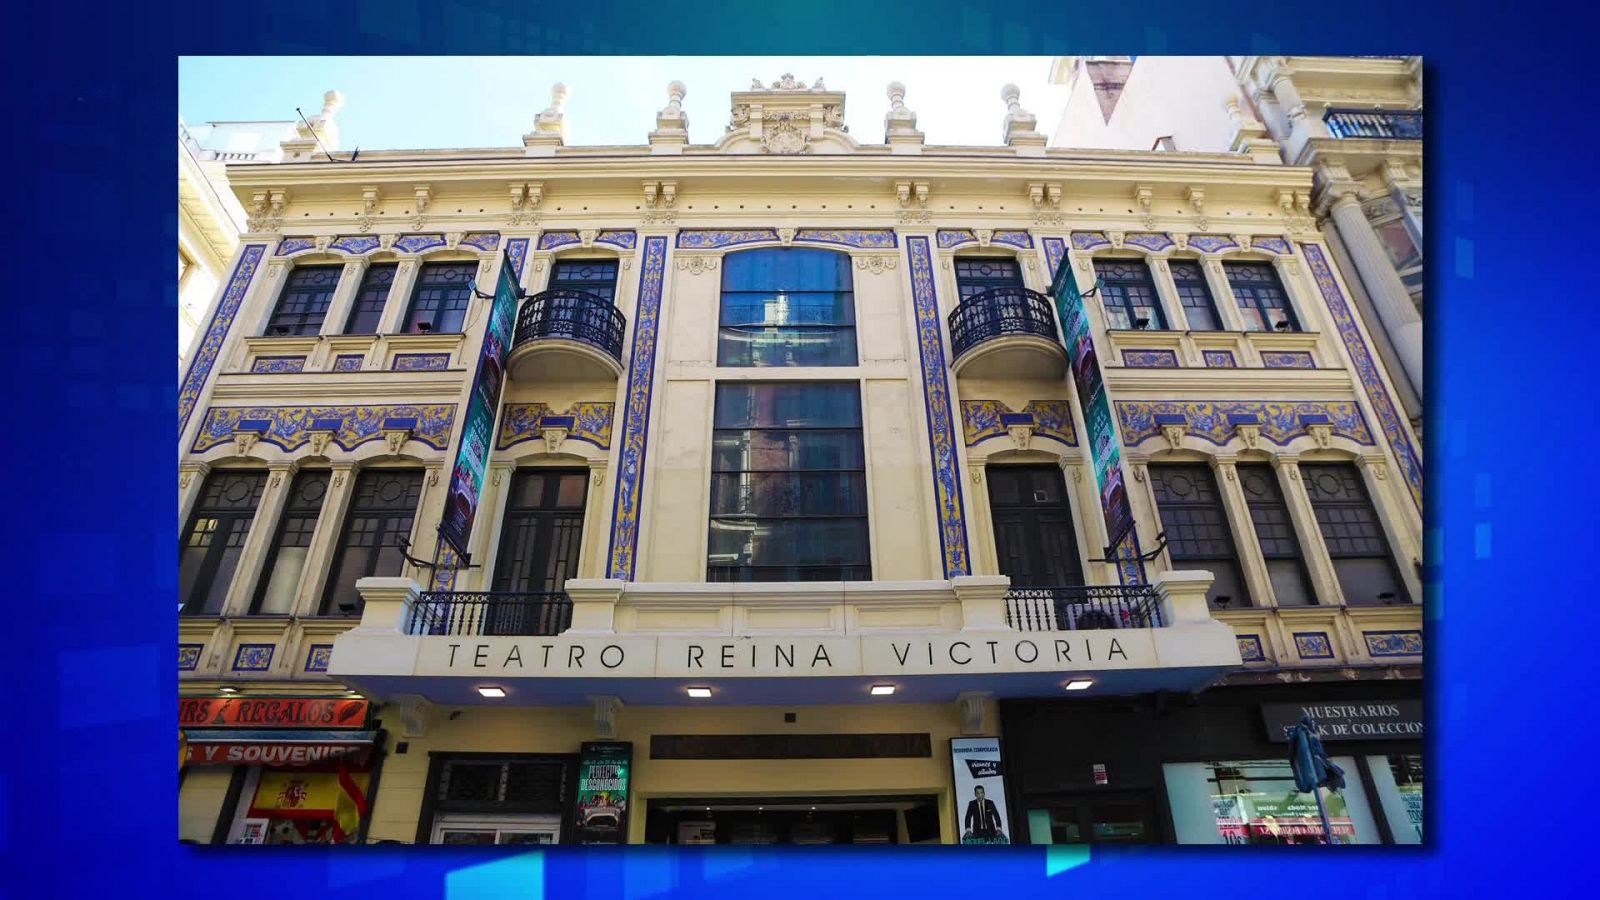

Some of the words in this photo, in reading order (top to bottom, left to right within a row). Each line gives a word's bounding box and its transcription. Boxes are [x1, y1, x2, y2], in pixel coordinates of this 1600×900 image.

[447, 644, 625, 669] TEATRO
[686, 643, 833, 669] REINA
[891, 637, 1129, 667] VICTORIA
[236, 701, 337, 723] REGALOS
[1300, 703, 1400, 719] MUESTRARIOS
[1332, 723, 1351, 735] DE
[204, 745, 220, 761] Y
[580, 778, 626, 791] DESCONOCIDOS
